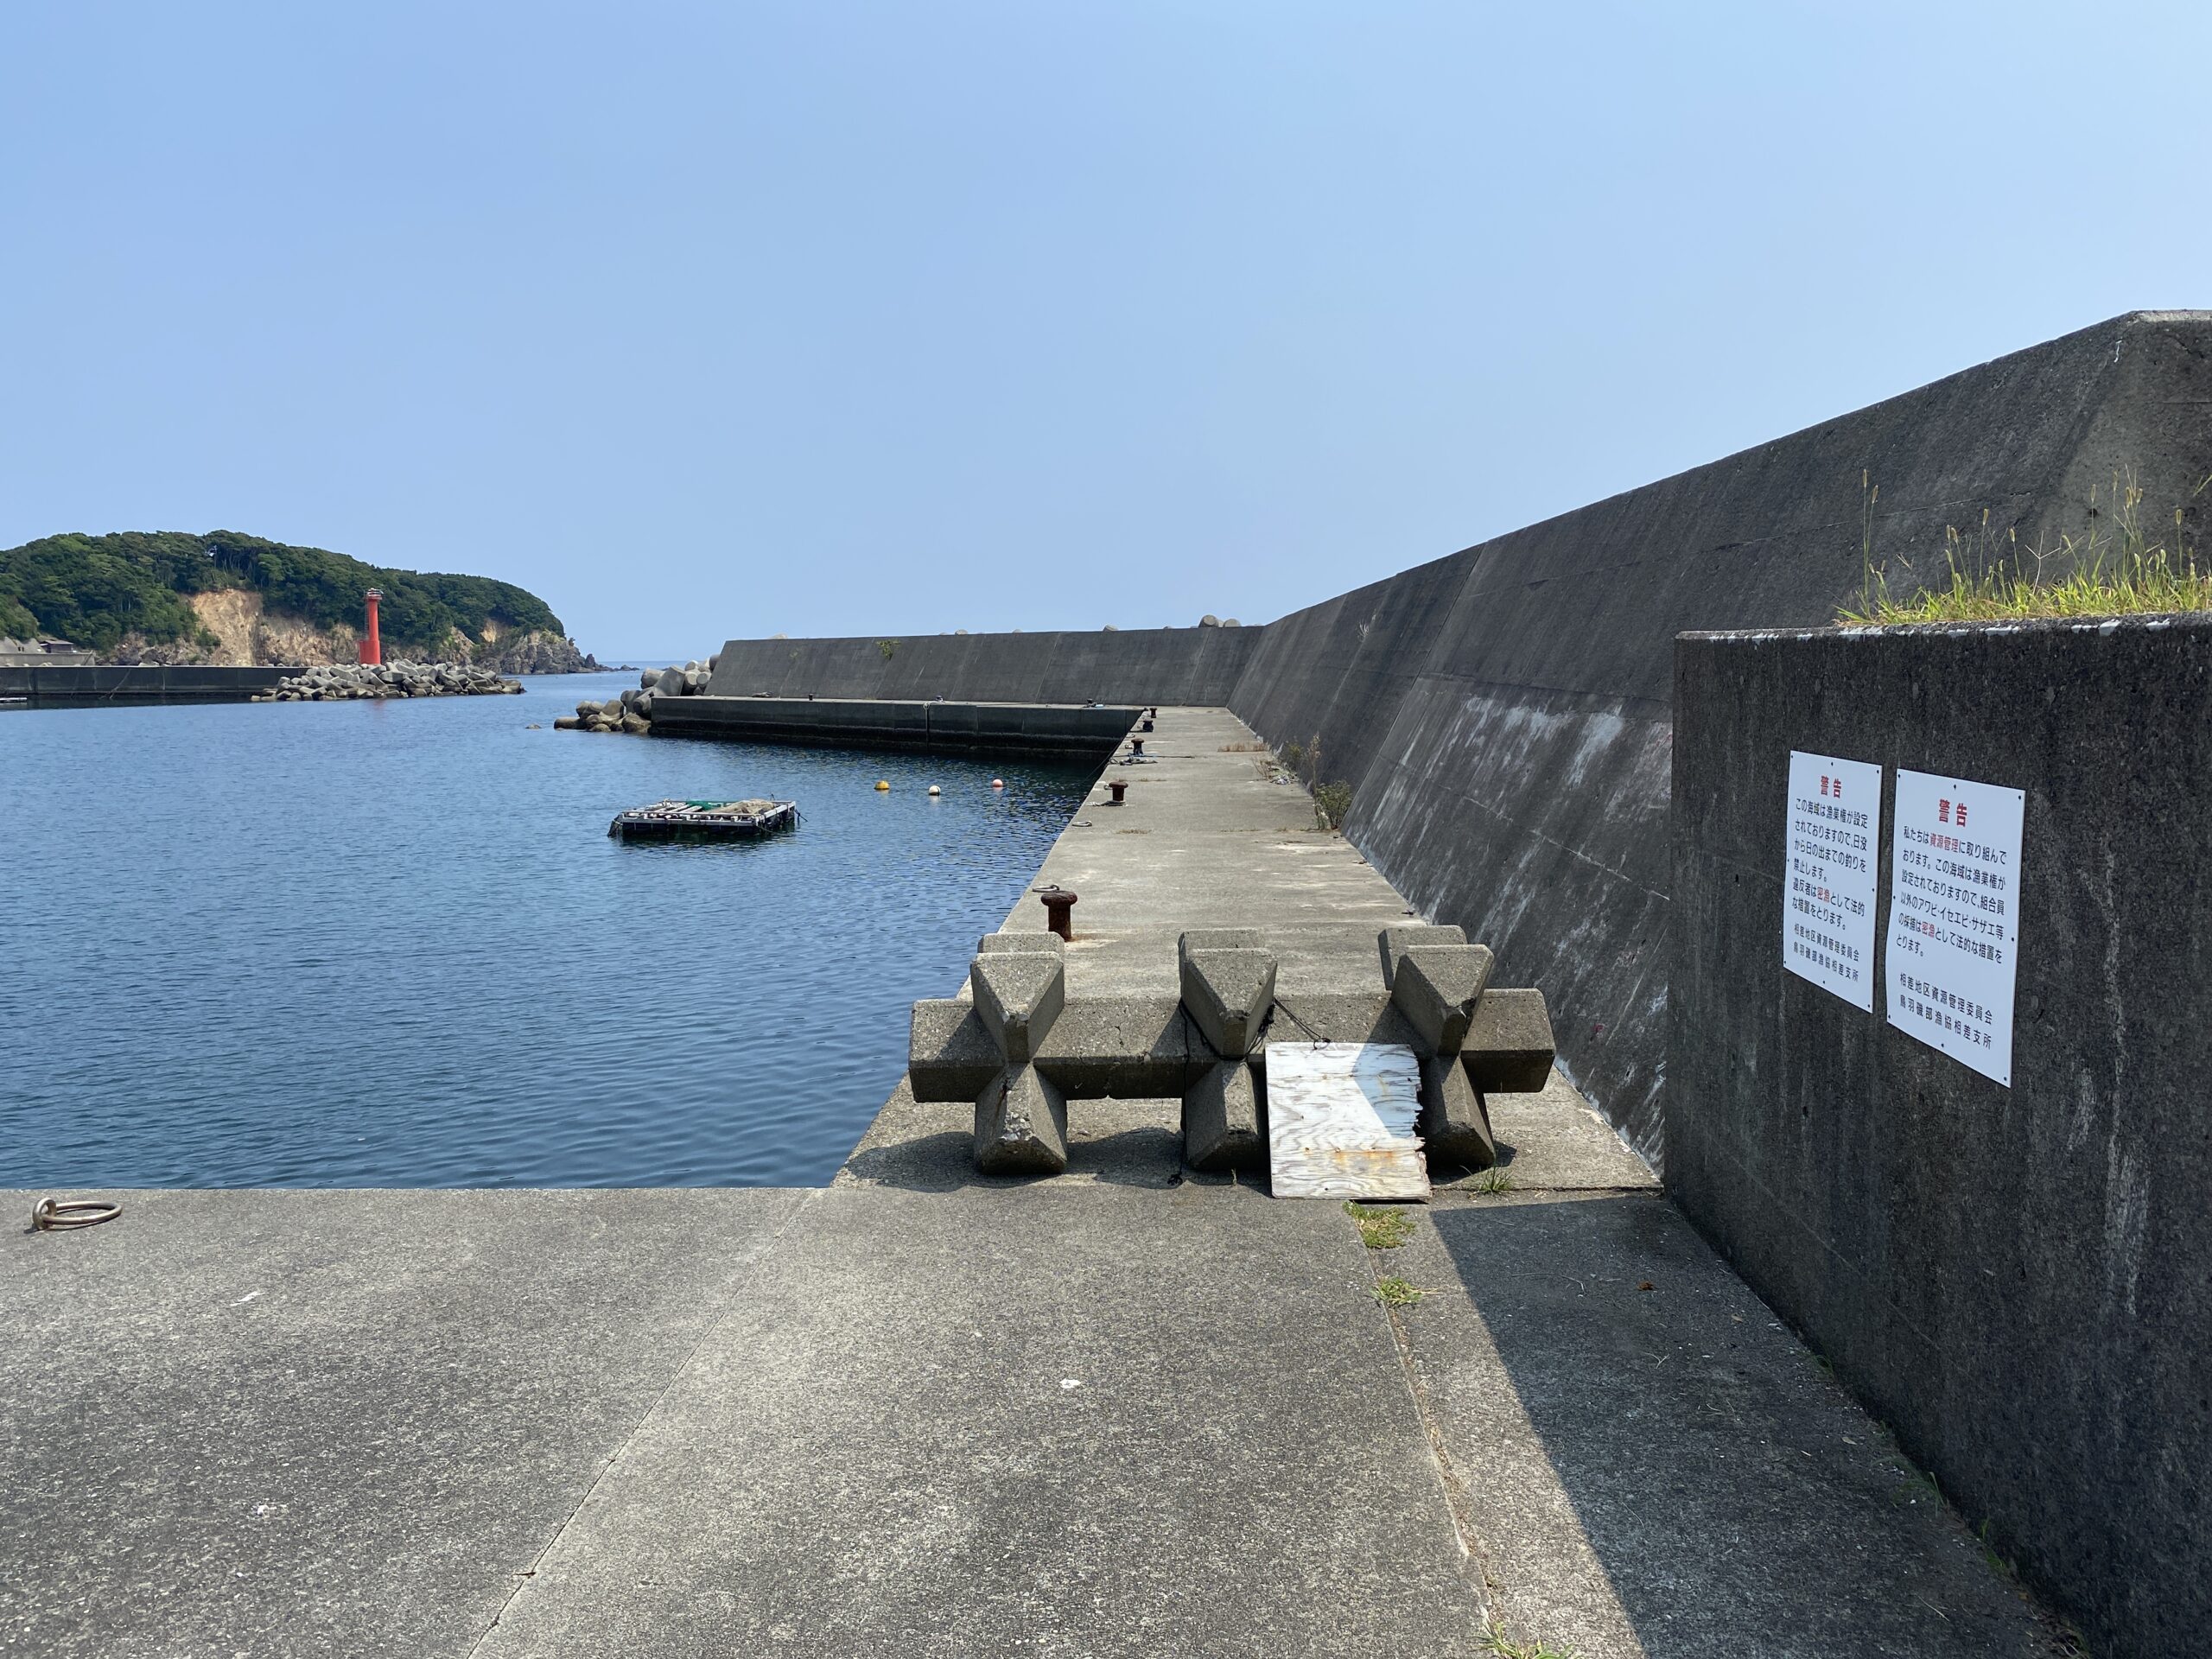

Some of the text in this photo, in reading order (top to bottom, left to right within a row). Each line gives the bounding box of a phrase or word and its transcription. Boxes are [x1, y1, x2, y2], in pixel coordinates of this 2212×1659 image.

[1821, 775, 1841, 798] 警告
[1796, 798, 1867, 829] この海域は漁業権が設定
[1939, 798, 1967, 828] 警告
[1794, 838, 1866, 873] から日の出までの釣りを
[1904, 825, 2007, 865] 私たちは資源管理に取り組んで
[1793, 858, 1827, 882] 禁止します。
[1792, 897, 1846, 931] な措置をとります。
[1793, 877, 1866, 917] 違反者は密漁として法的
[1794, 923, 1859, 962] 相差地区資源管理委員会
[1896, 935, 1924, 957] とります。
[1900, 972, 1993, 1026] 相差地区資源管理委員会
[1900, 995, 1992, 1050] 鳥羽磯部漁協相差支所
